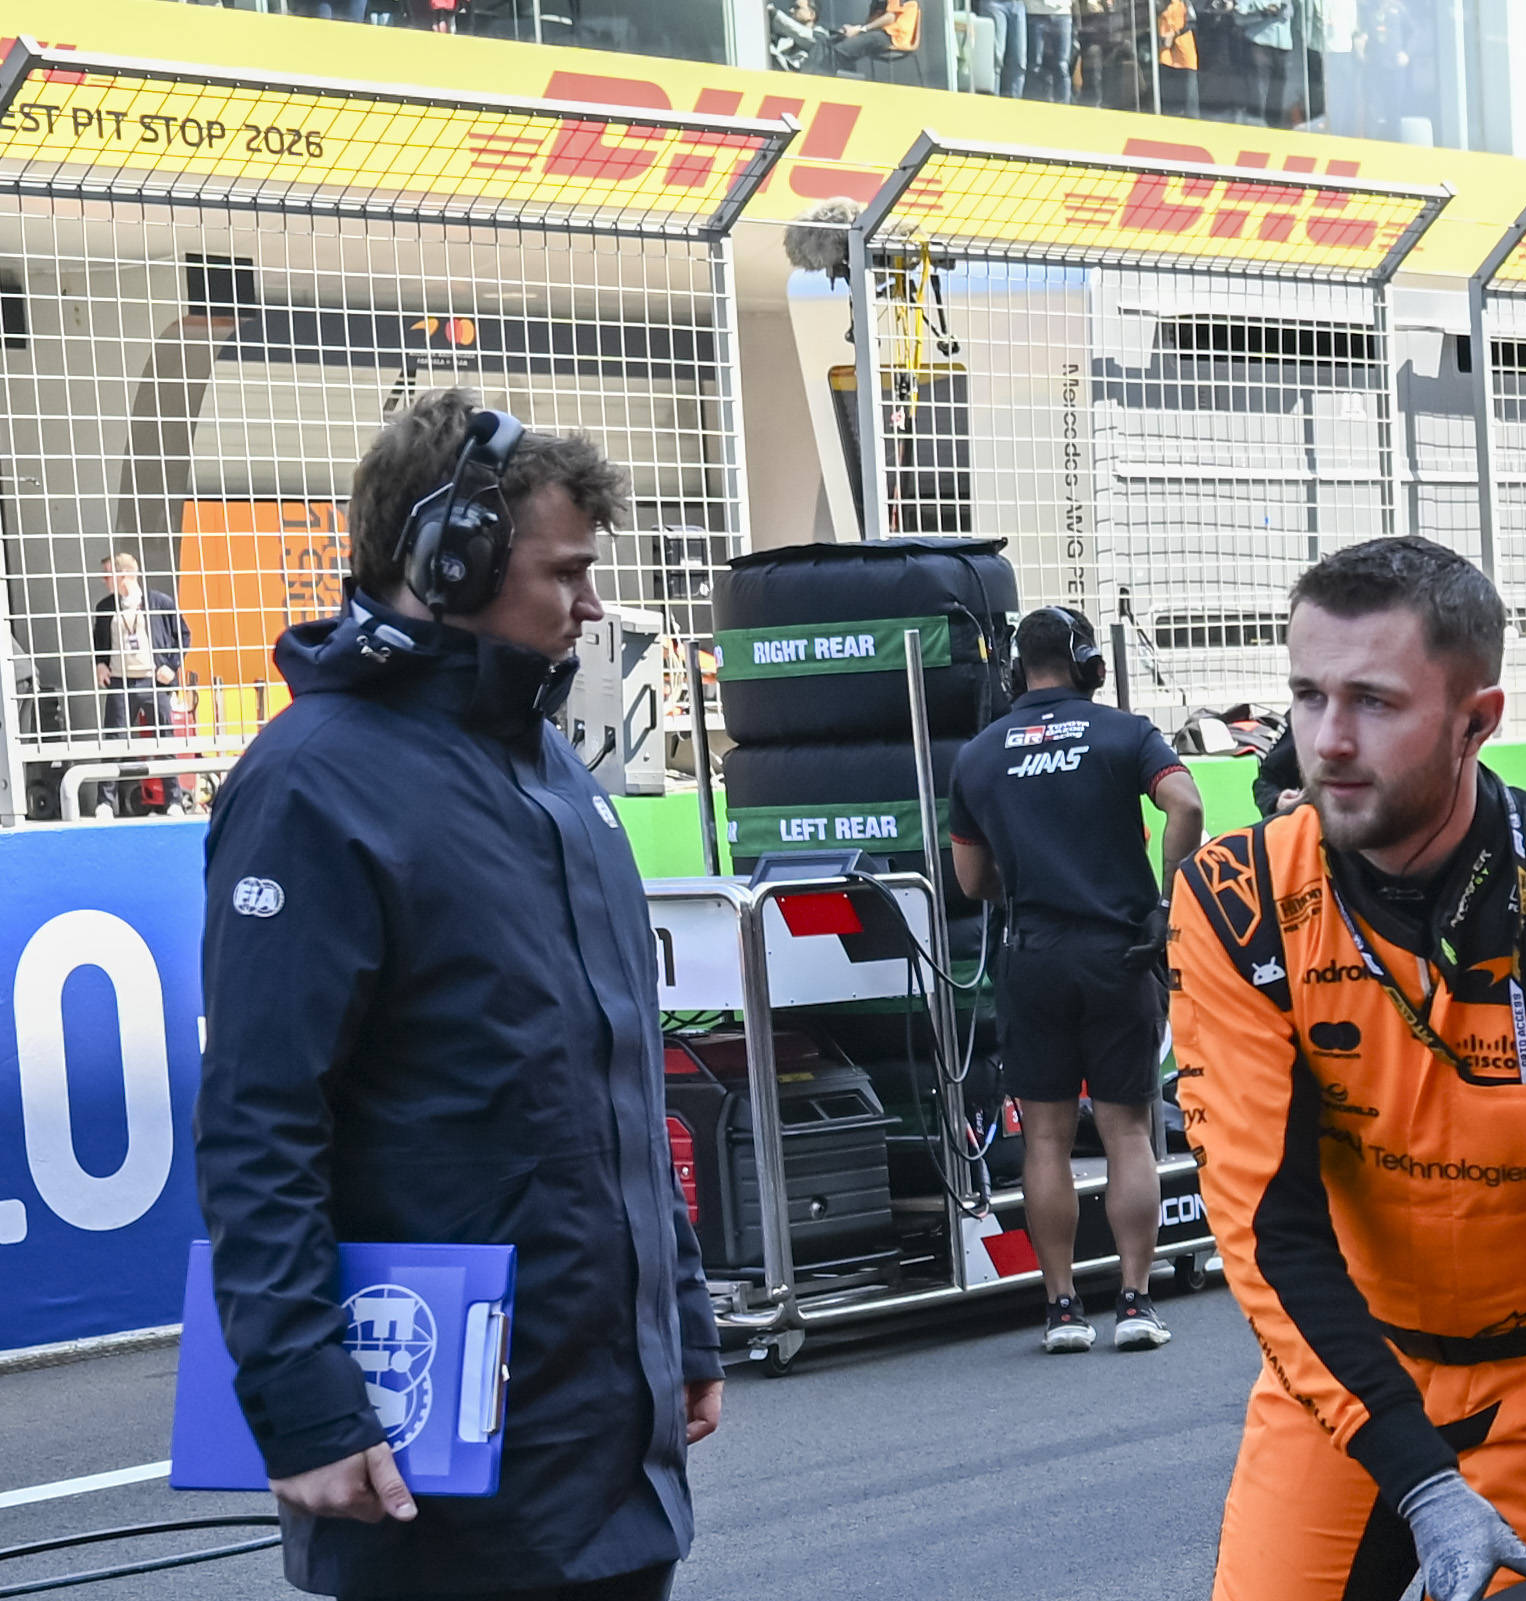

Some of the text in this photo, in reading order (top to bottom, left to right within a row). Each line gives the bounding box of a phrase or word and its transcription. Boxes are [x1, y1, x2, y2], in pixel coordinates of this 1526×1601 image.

[72, 107, 128, 140] PIT
[140, 114, 225, 148] STOP
[244, 123, 324, 158] 2026
[544, 70, 884, 203] DHL
[1116, 138, 1380, 247] DHL
[753, 639, 807, 665] RIGHT
[814, 634, 876, 659] REAR
[1006, 731, 1045, 748] GR
[1008, 745, 1090, 778] HAAS
[780, 815, 898, 842] LEFT REAR
[239, 882, 280, 911] FIA
[1303, 959, 1368, 984] ndro
[1159, 1194, 1208, 1227] CON
